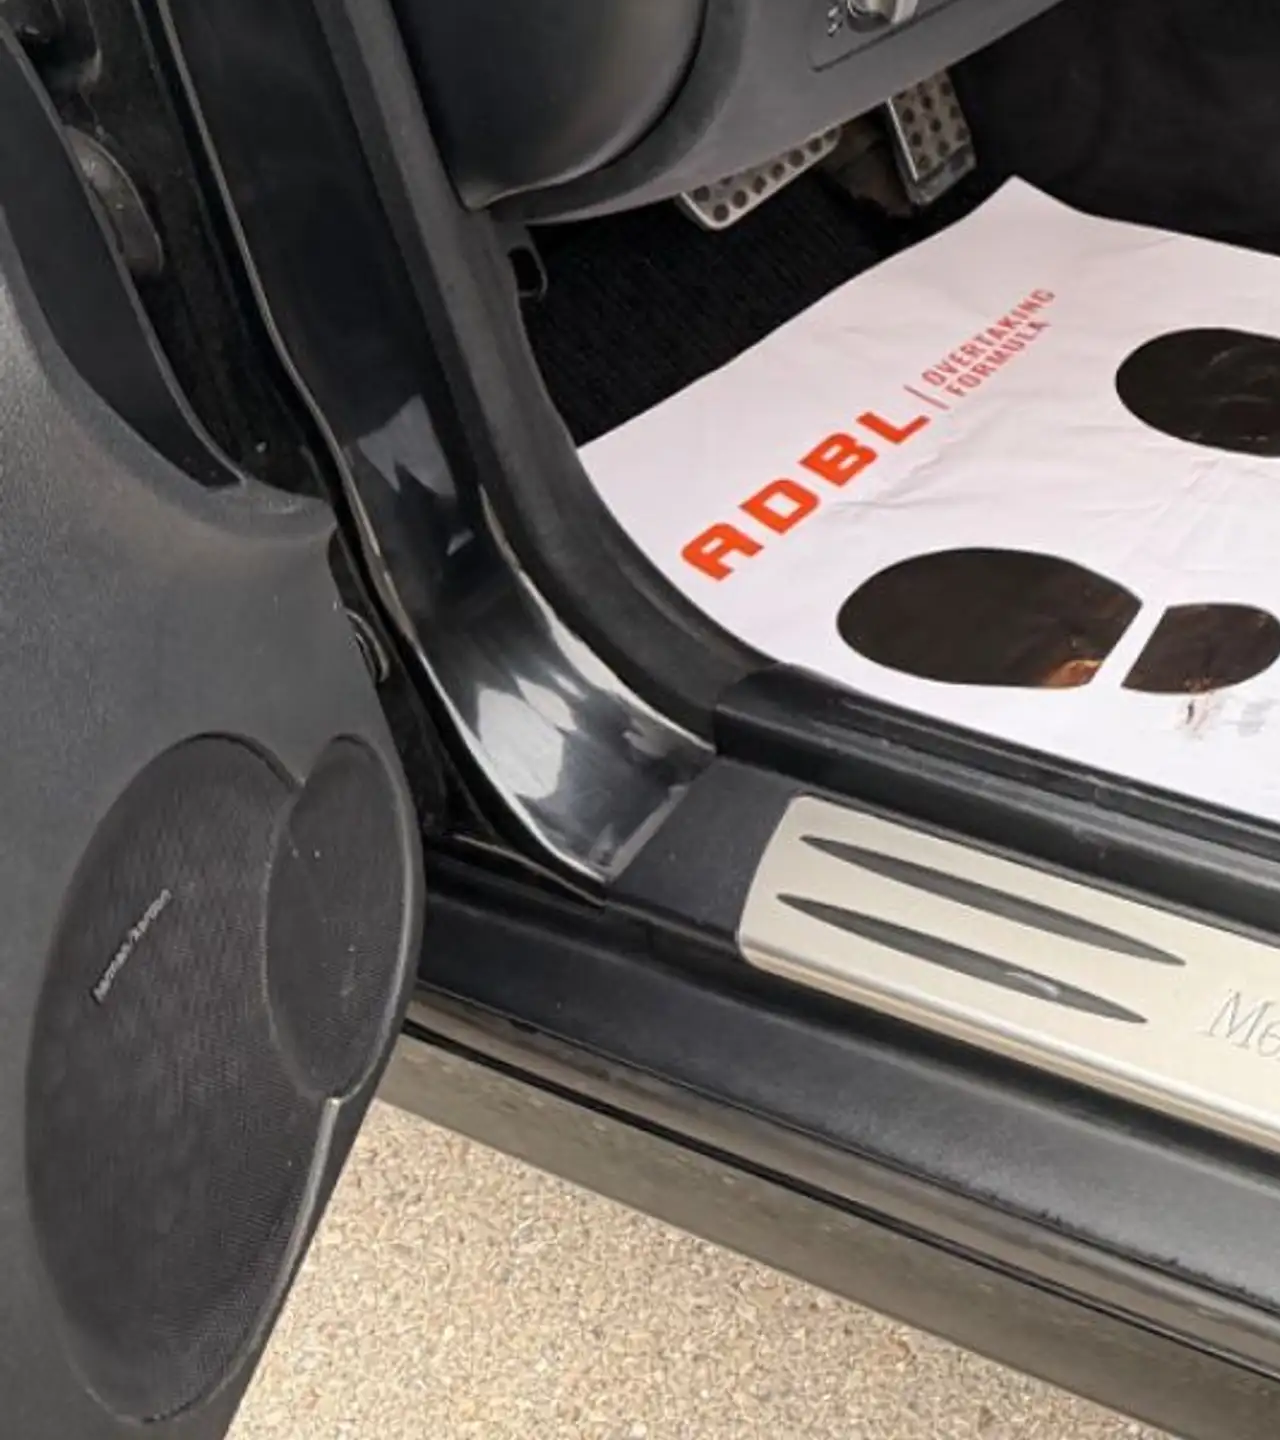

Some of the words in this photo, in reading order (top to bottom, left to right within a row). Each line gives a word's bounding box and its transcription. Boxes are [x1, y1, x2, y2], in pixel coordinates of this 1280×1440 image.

[920, 288, 1056, 387] OVERTAKING
[945, 321, 1052, 397] FORMULA
[681, 411, 931, 581] ADBL
